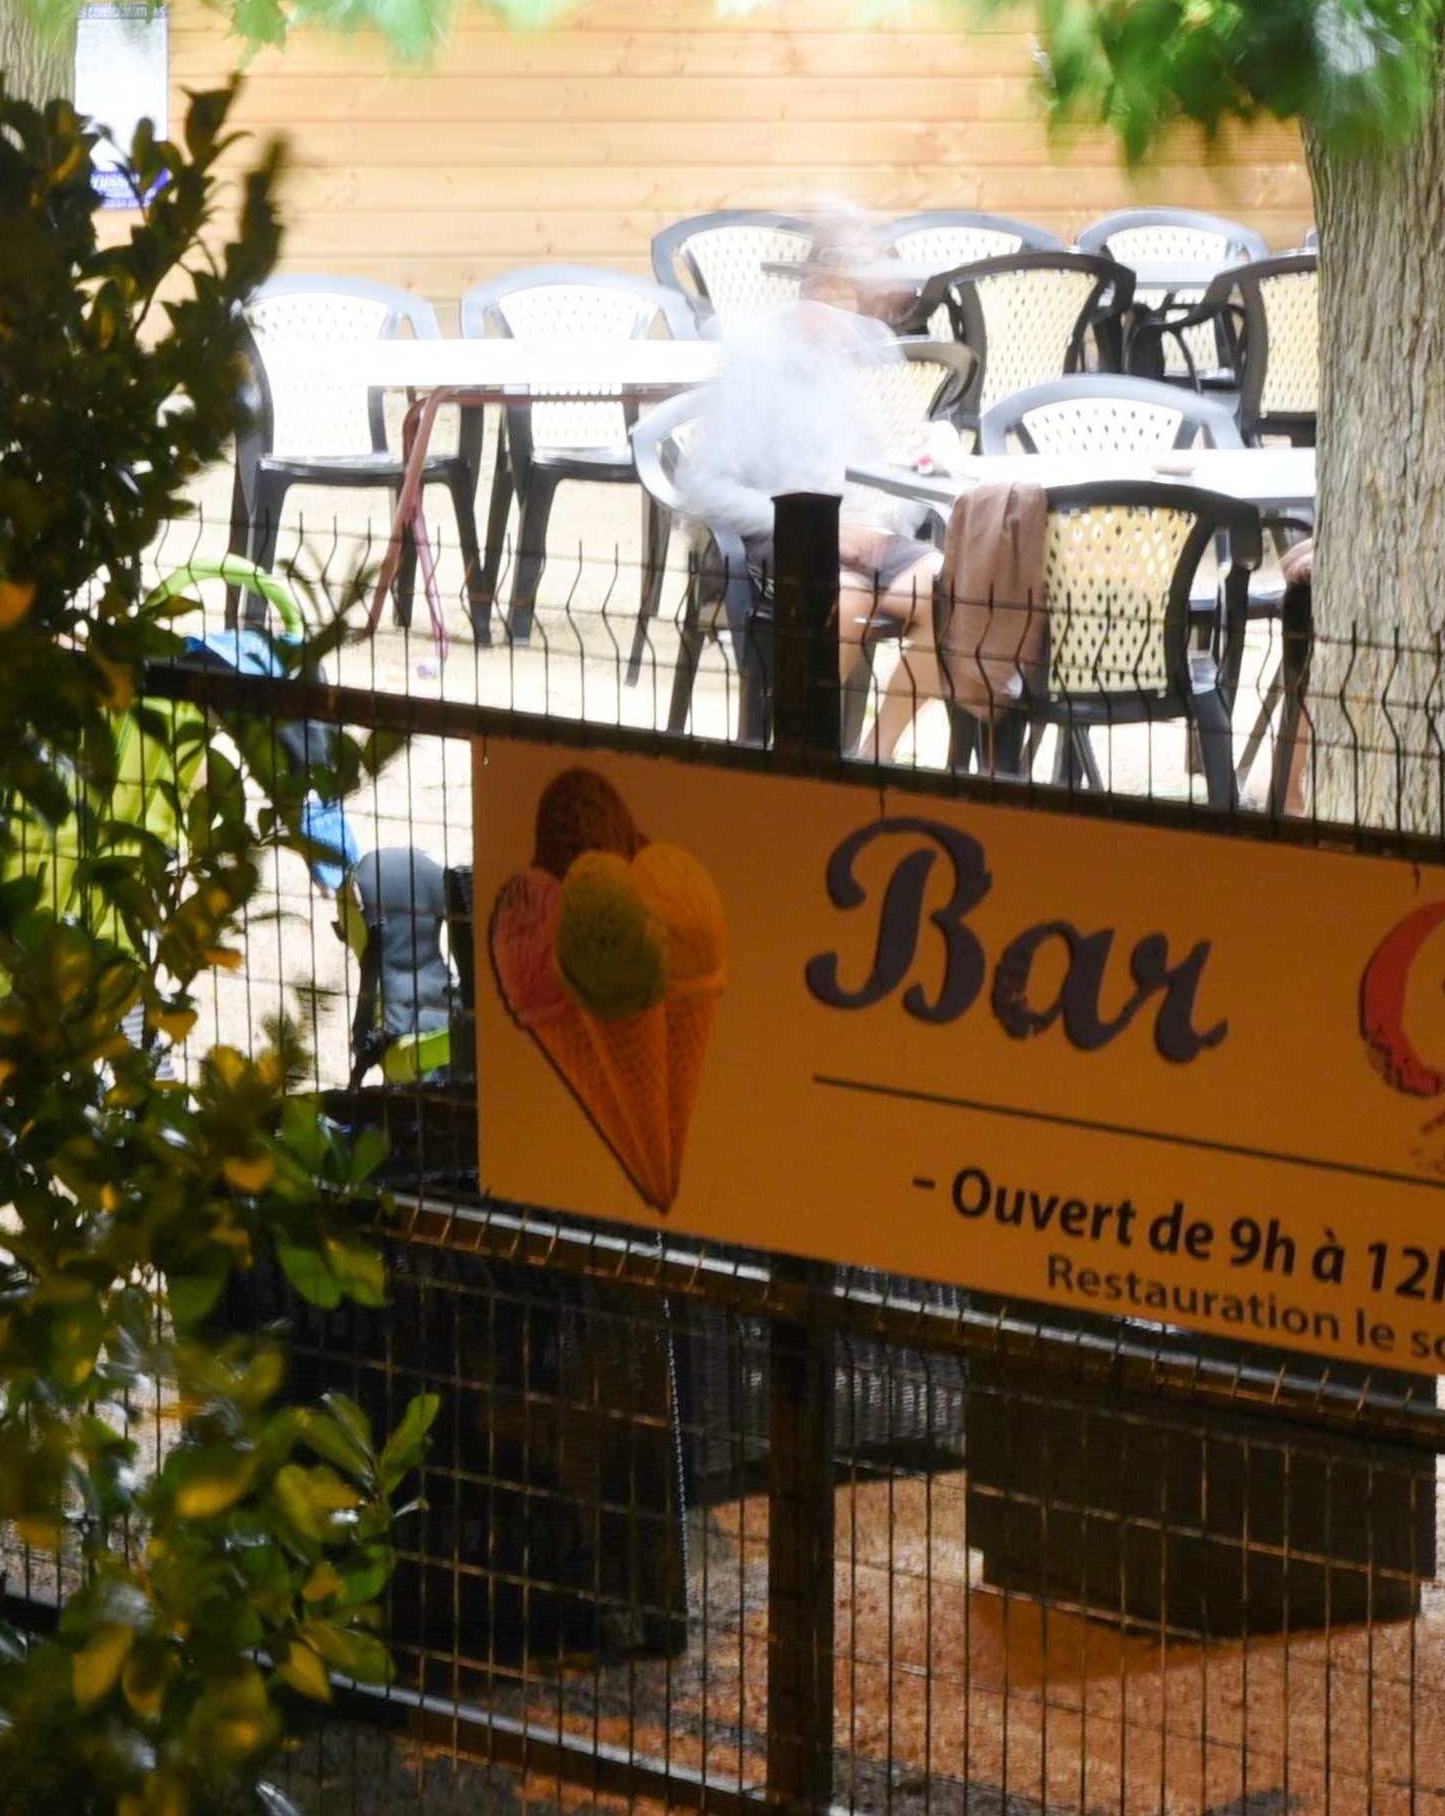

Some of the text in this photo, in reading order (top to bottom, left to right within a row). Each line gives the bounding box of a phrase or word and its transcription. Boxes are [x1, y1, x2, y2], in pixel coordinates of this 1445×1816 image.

[804, 817, 1228, 1065] Bar
[951, 1167, 1136, 1247] Ouvert
[1149, 1202, 1214, 1260] de
[1229, 1217, 1295, 1276] 9h
[1312, 1228, 1345, 1286] à
[1047, 1254, 1340, 1344] Restauration
[1357, 1308, 1396, 1353] le
